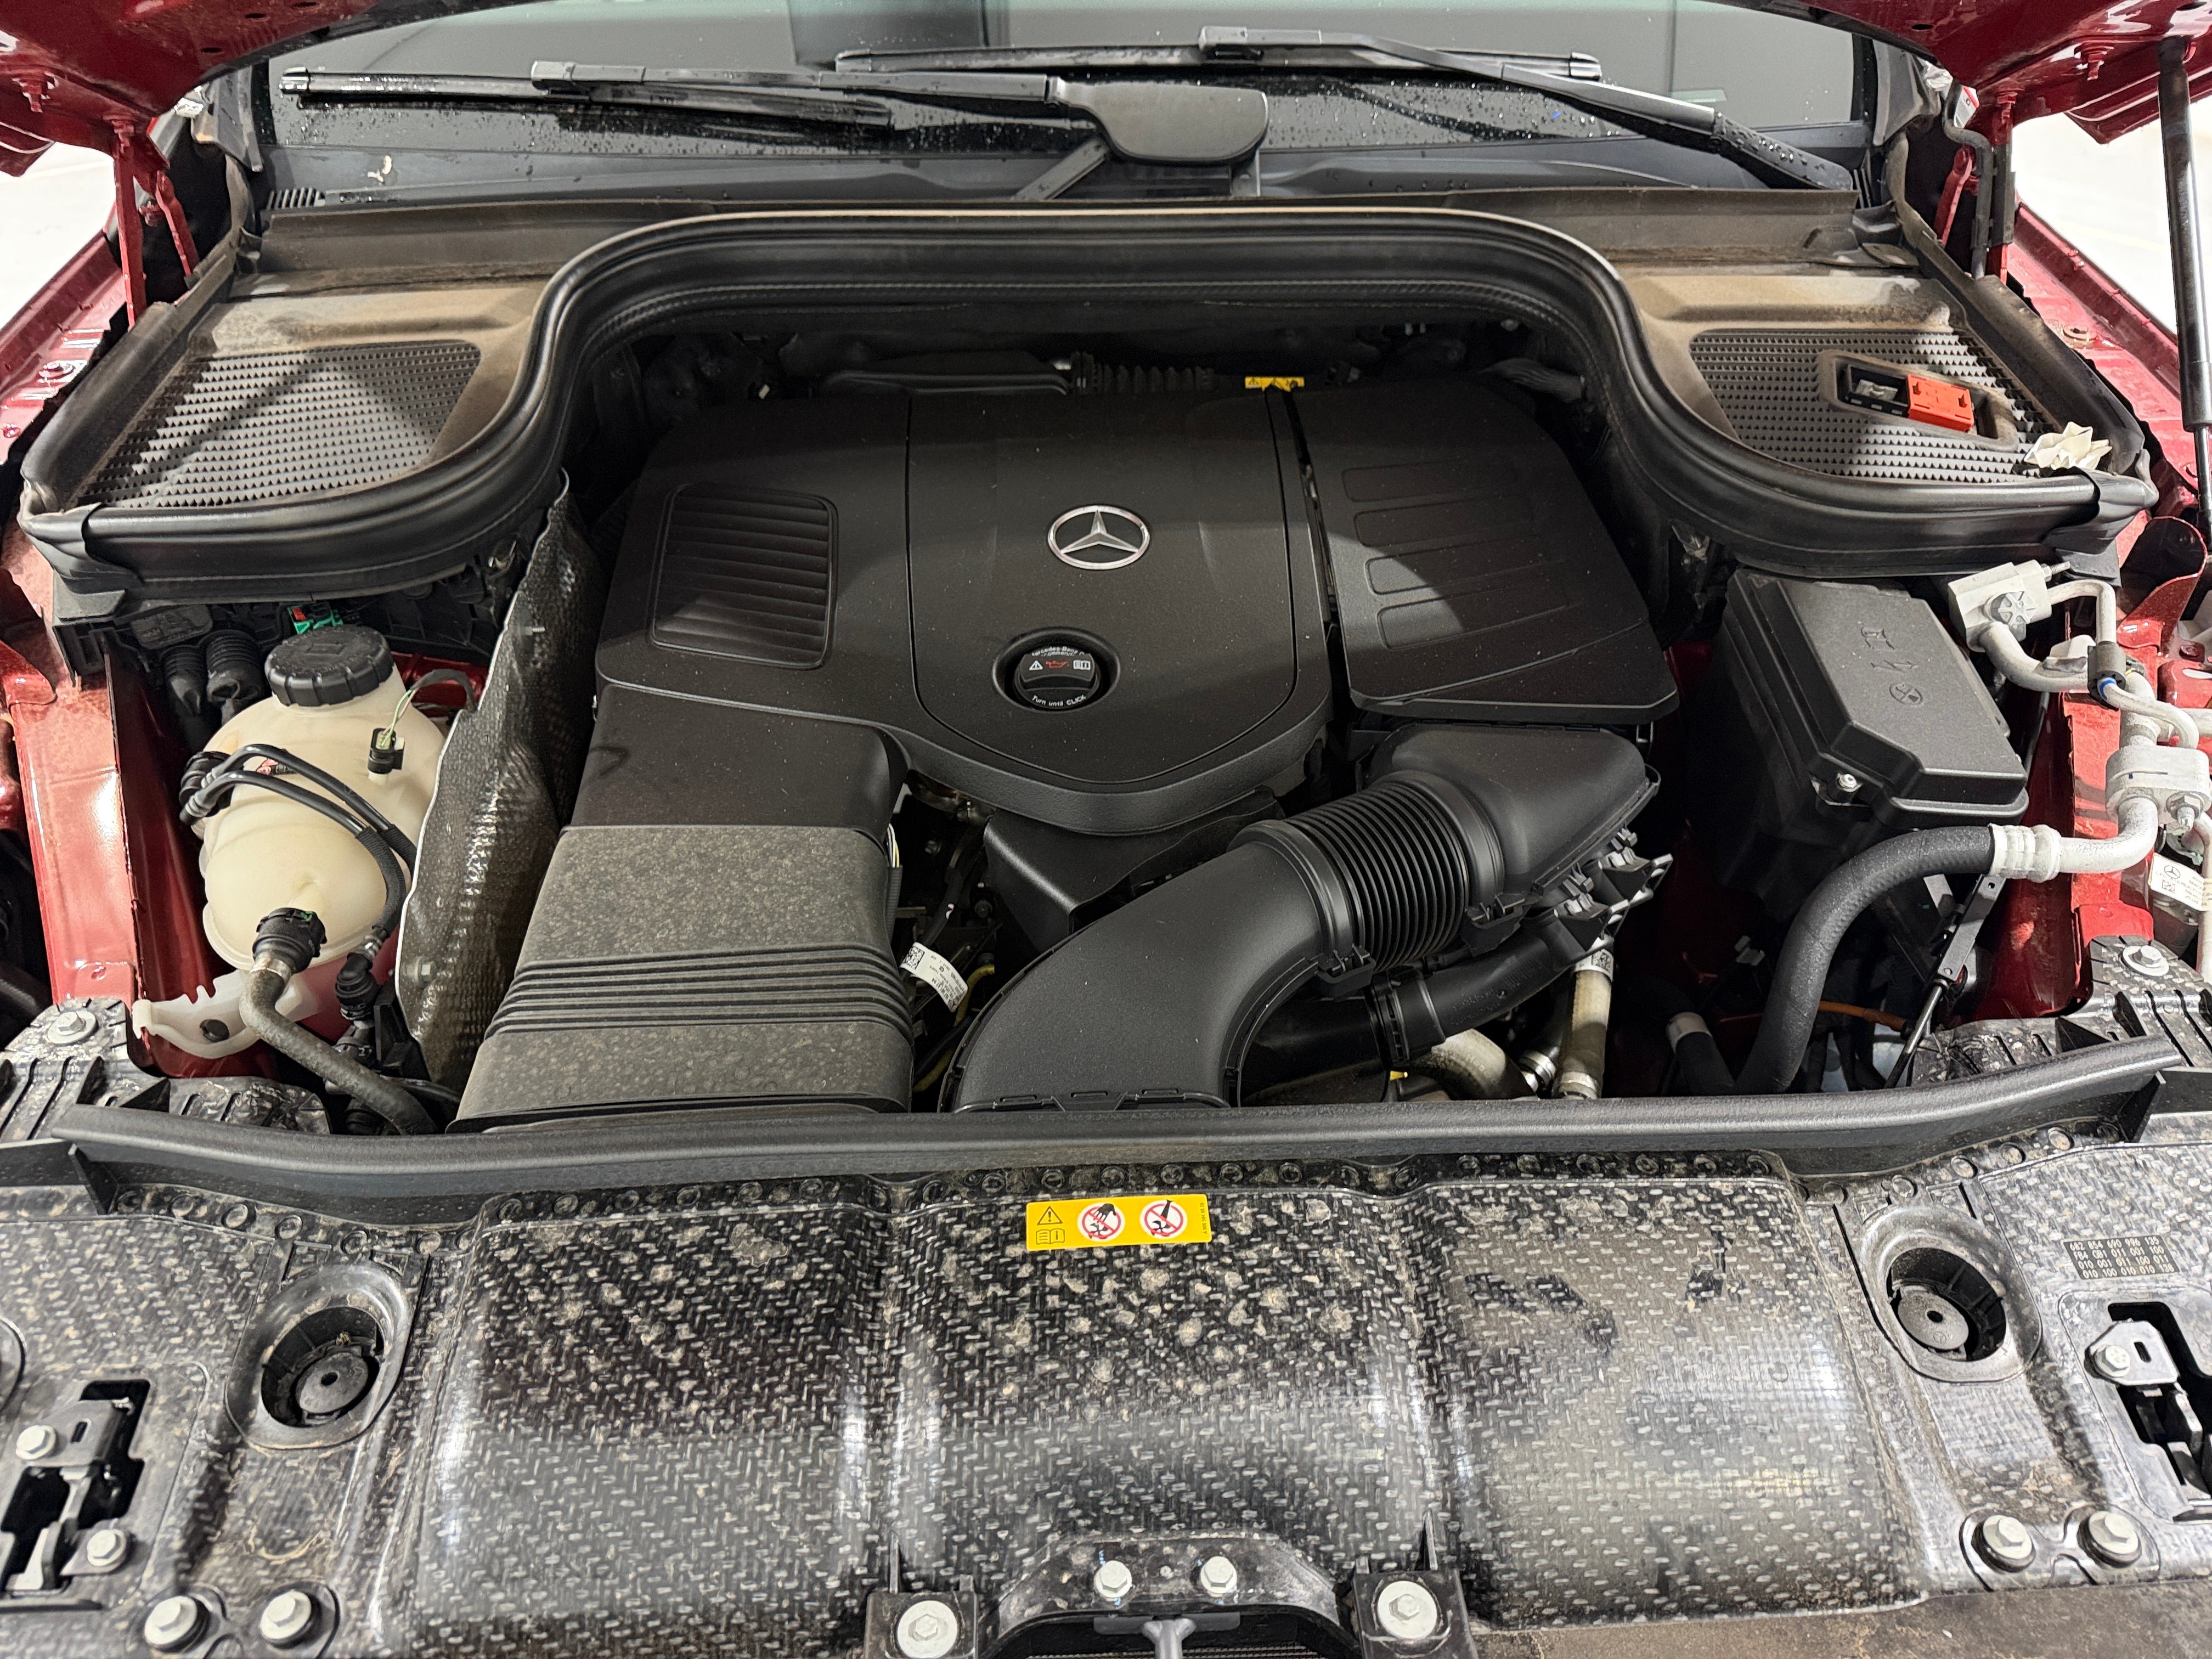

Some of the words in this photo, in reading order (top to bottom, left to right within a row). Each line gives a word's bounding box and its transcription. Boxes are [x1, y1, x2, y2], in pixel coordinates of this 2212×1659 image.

[1032, 695, 1046, 706] Turn
[1066, 694, 1086, 706] CLICK
[2069, 1242, 2085, 1251] 682
[2087, 1240, 2103, 1250] 854
[2107, 1239, 2122, 1249] 690
[2124, 1238, 2141, 1248] 996
[2145, 1236, 2160, 1246] 135
[2111, 1248, 2126, 1258] 011
[2129, 1246, 2146, 1256] 001
[2149, 1245, 2165, 1255] 100
[2078, 1260, 2094, 1270] 010
[2097, 1259, 2113, 1268] 001
[2115, 1257, 2131, 1267] 011
[2135, 1255, 2151, 1266] 100
[2153, 1254, 2169, 1265] 011
[2083, 1269, 2098, 1279] 010
[2102, 1267, 2118, 1278] 100
[2120, 1266, 2136, 1276] 010
[2139, 1265, 2155, 1274] 010
[2159, 1263, 2175, 1273] 138
